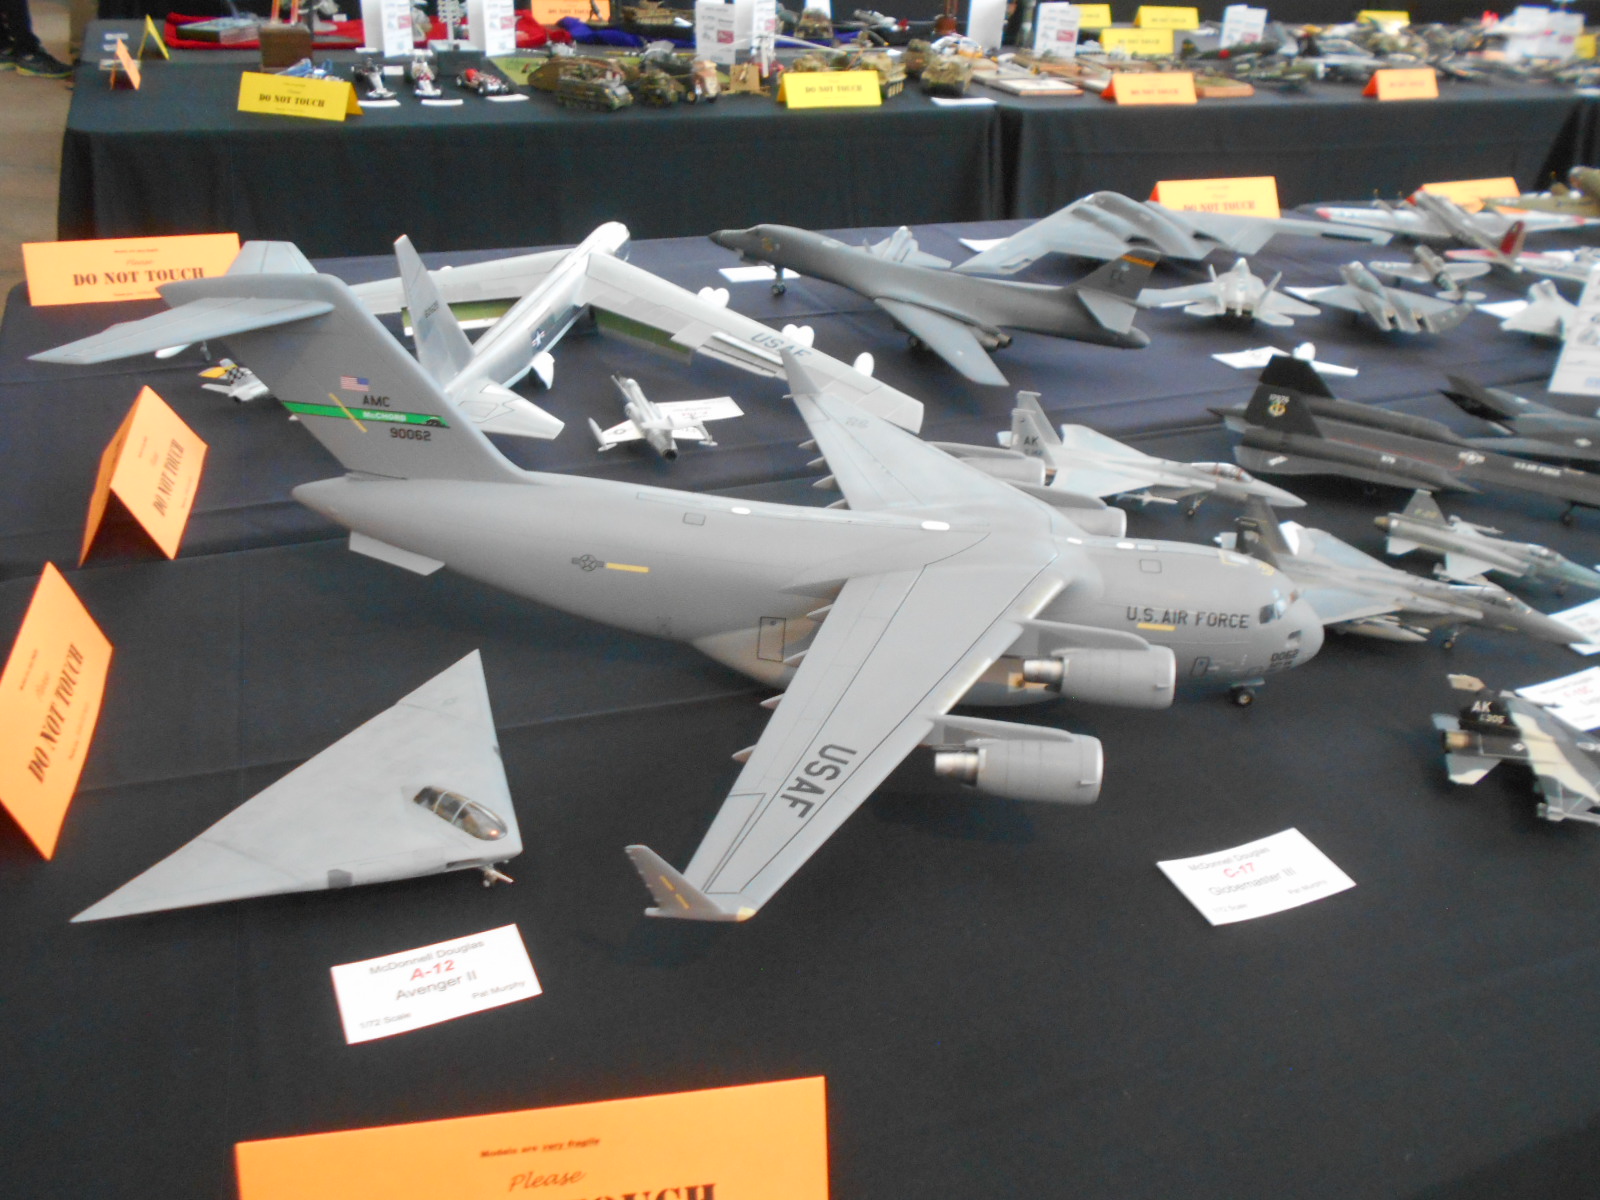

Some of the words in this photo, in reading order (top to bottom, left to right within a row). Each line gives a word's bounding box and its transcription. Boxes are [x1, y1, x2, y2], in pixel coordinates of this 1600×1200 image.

[259, 93, 271, 102] DO
[274, 95, 291, 104] NOT
[295, 97, 325, 108] TOUCH
[73, 273, 98, 286] DO
[104, 271, 140, 285] NOT
[144, 267, 205, 282] TOUCH
[363, 395, 390, 407] AMC
[390, 427, 431, 441] 90062
[1023, 436, 1039, 445] AK
[157, 472, 176, 500] NOT
[1126, 606, 1159, 623] U.S.
[1162, 609, 1189, 625] AIR
[1195, 611, 1250, 629] FORCE
[27, 746, 49, 784] DO
[40, 702, 66, 751] NOT
[54, 642, 84, 708] TOUCH
[1472, 700, 1493, 712] AK
[780, 743, 858, 819] USAF
[1223, 862, 1256, 878] C-17
[369, 952, 434, 975] McDonnell
[436, 940, 485, 960] Douglas
[410, 959, 456, 981] A-12
[395, 973, 463, 1001] Avenger
[466, 969, 478, 982] II
[359, 1018, 381, 1030] 1/72
[383, 1011, 412, 1025] Scale
[508, 1170, 588, 1193] Please
